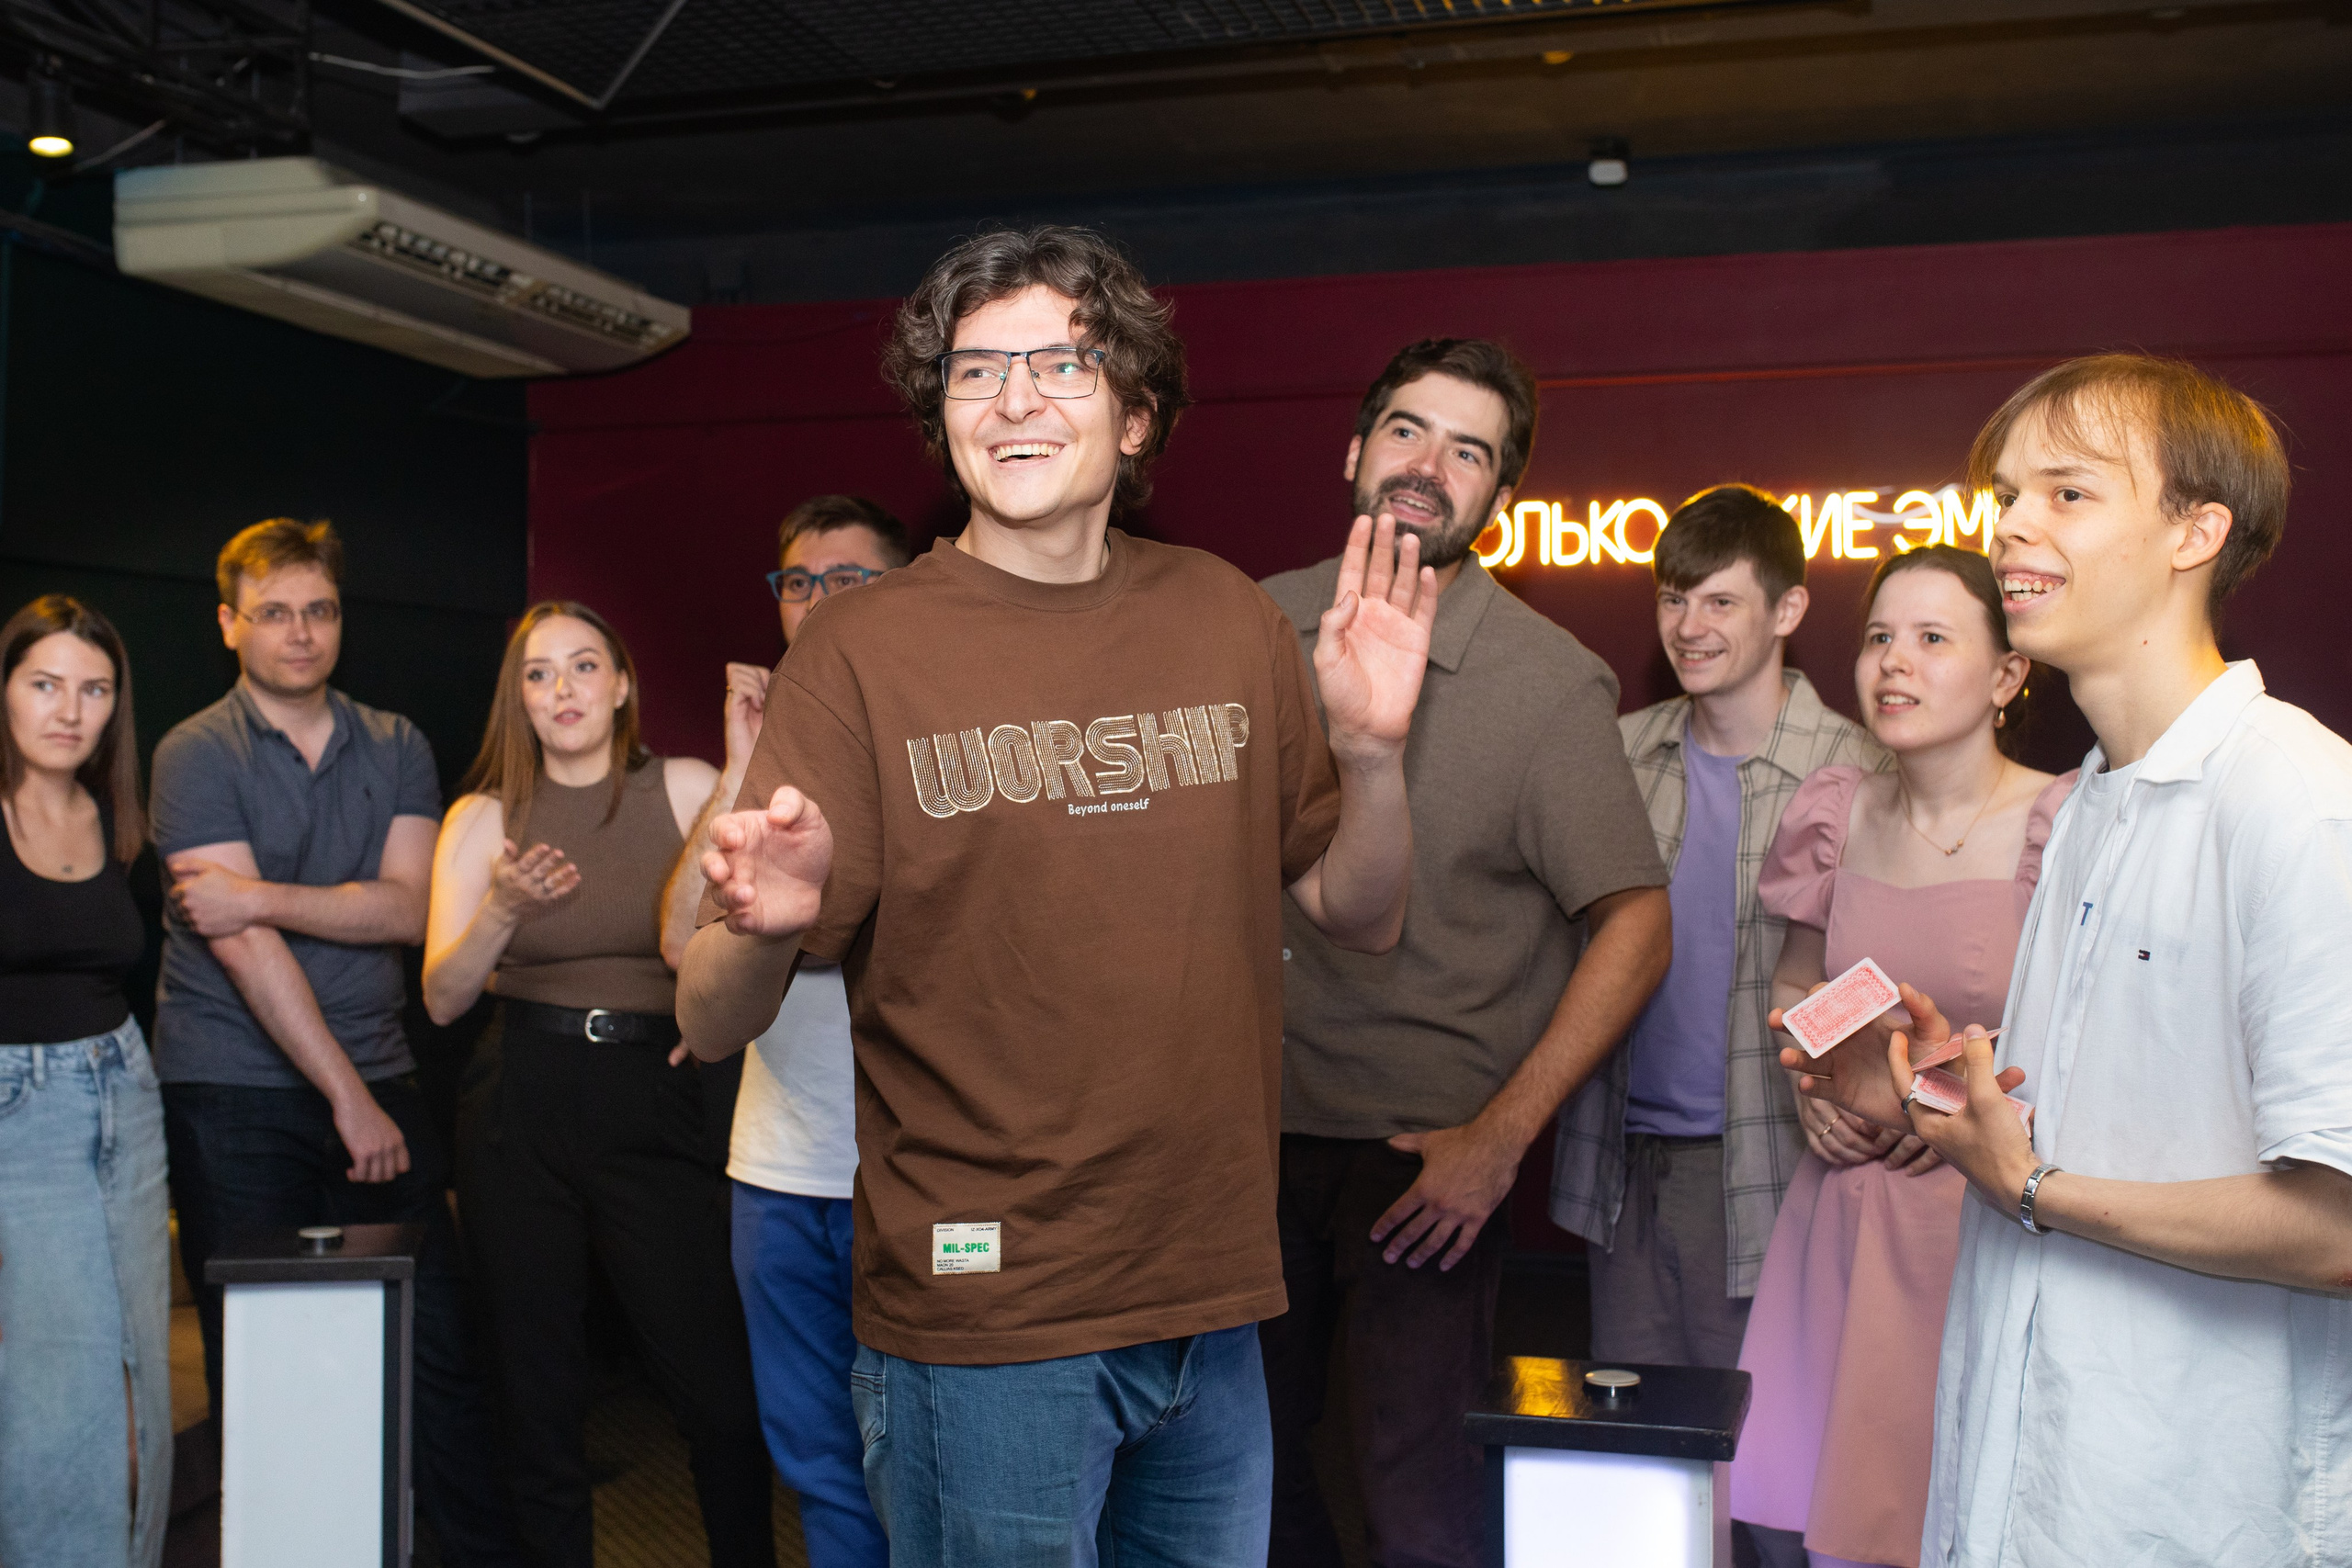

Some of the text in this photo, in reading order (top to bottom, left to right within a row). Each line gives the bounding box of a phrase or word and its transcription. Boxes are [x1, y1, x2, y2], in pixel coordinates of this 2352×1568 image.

[1781, 491, 1880, 559] ИЕ
[1893, 489, 2001, 555] ЭМ
[907, 703, 1250, 818] WORSHIP
[1068, 797, 1150, 817] Beyond oneself
[943, 1242, 989, 1253] MIL-SPEC
